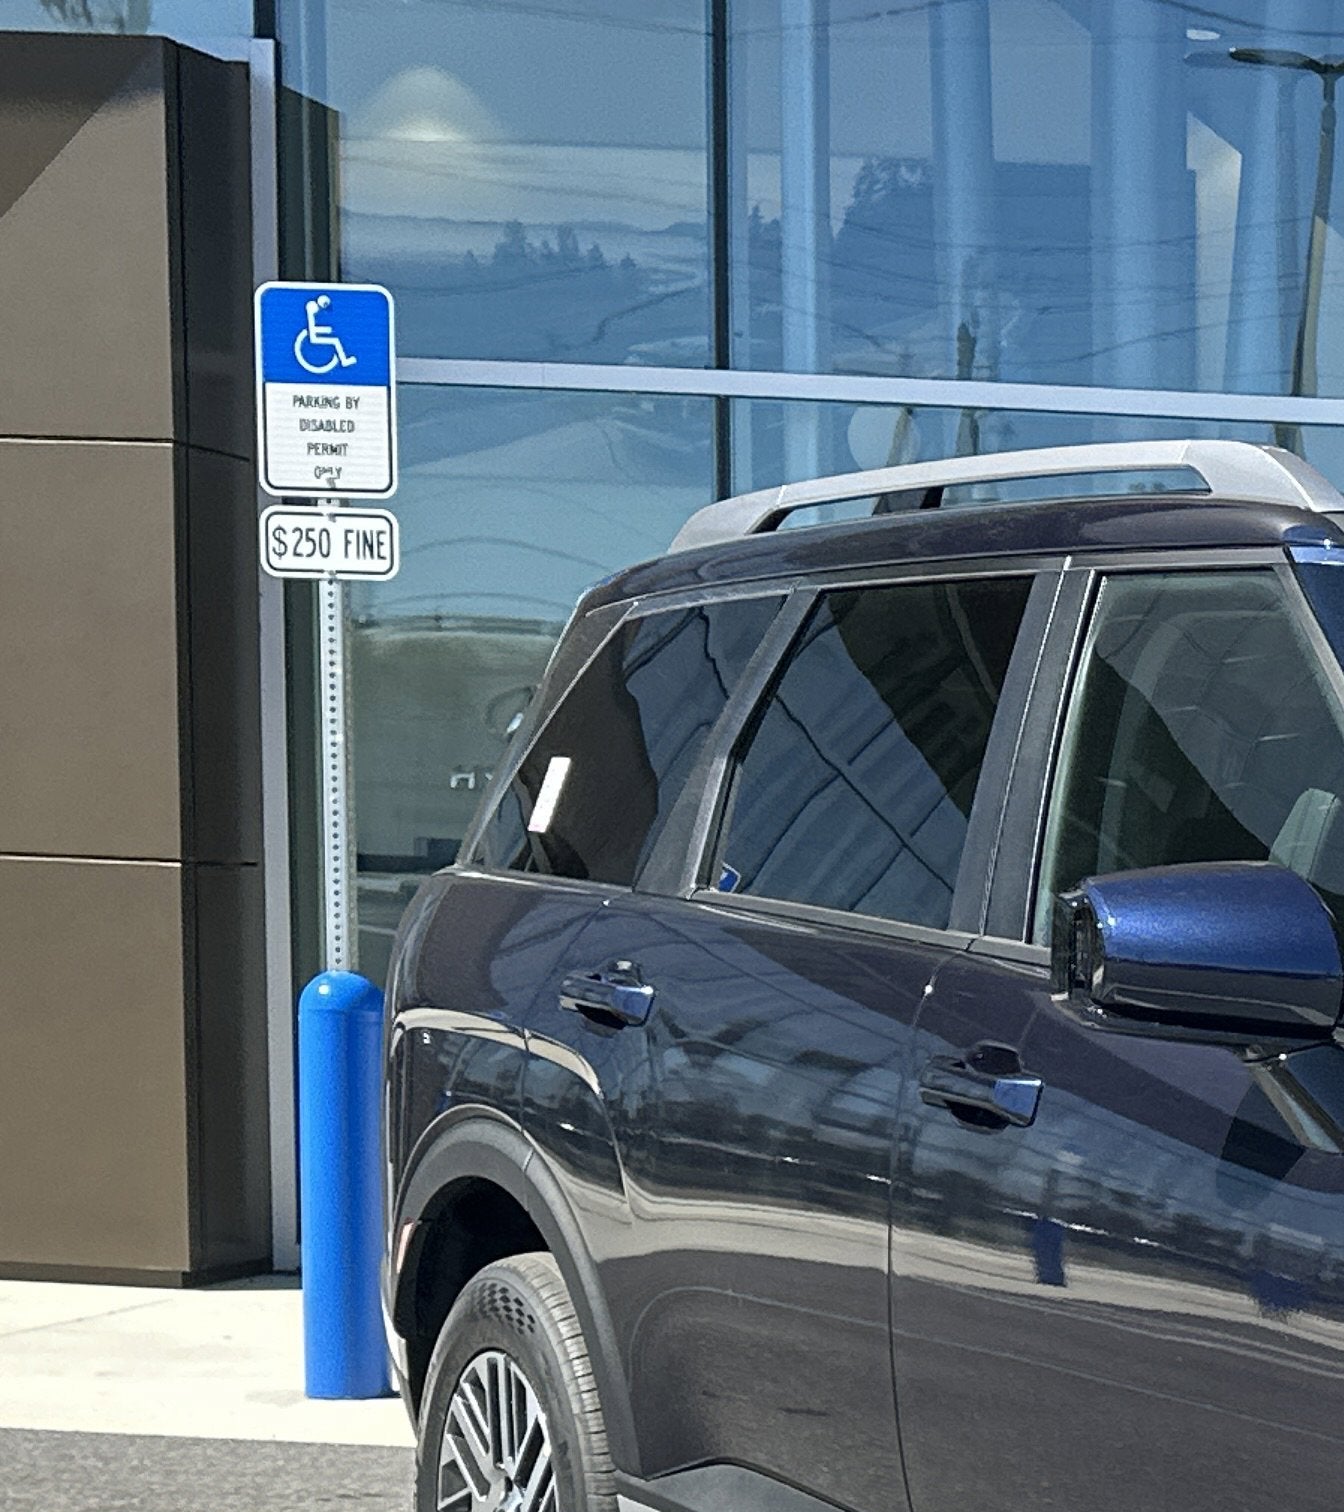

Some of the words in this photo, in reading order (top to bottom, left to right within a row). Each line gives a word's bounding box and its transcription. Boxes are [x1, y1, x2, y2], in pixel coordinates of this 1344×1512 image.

[293, 395, 340, 409] PARKING
[345, 396, 360, 410] BY
[299, 418, 355, 433] DISABLED
[307, 442, 348, 456] PERMIT
[272, 524, 331, 560] $250
[343, 527, 387, 560] FINE
